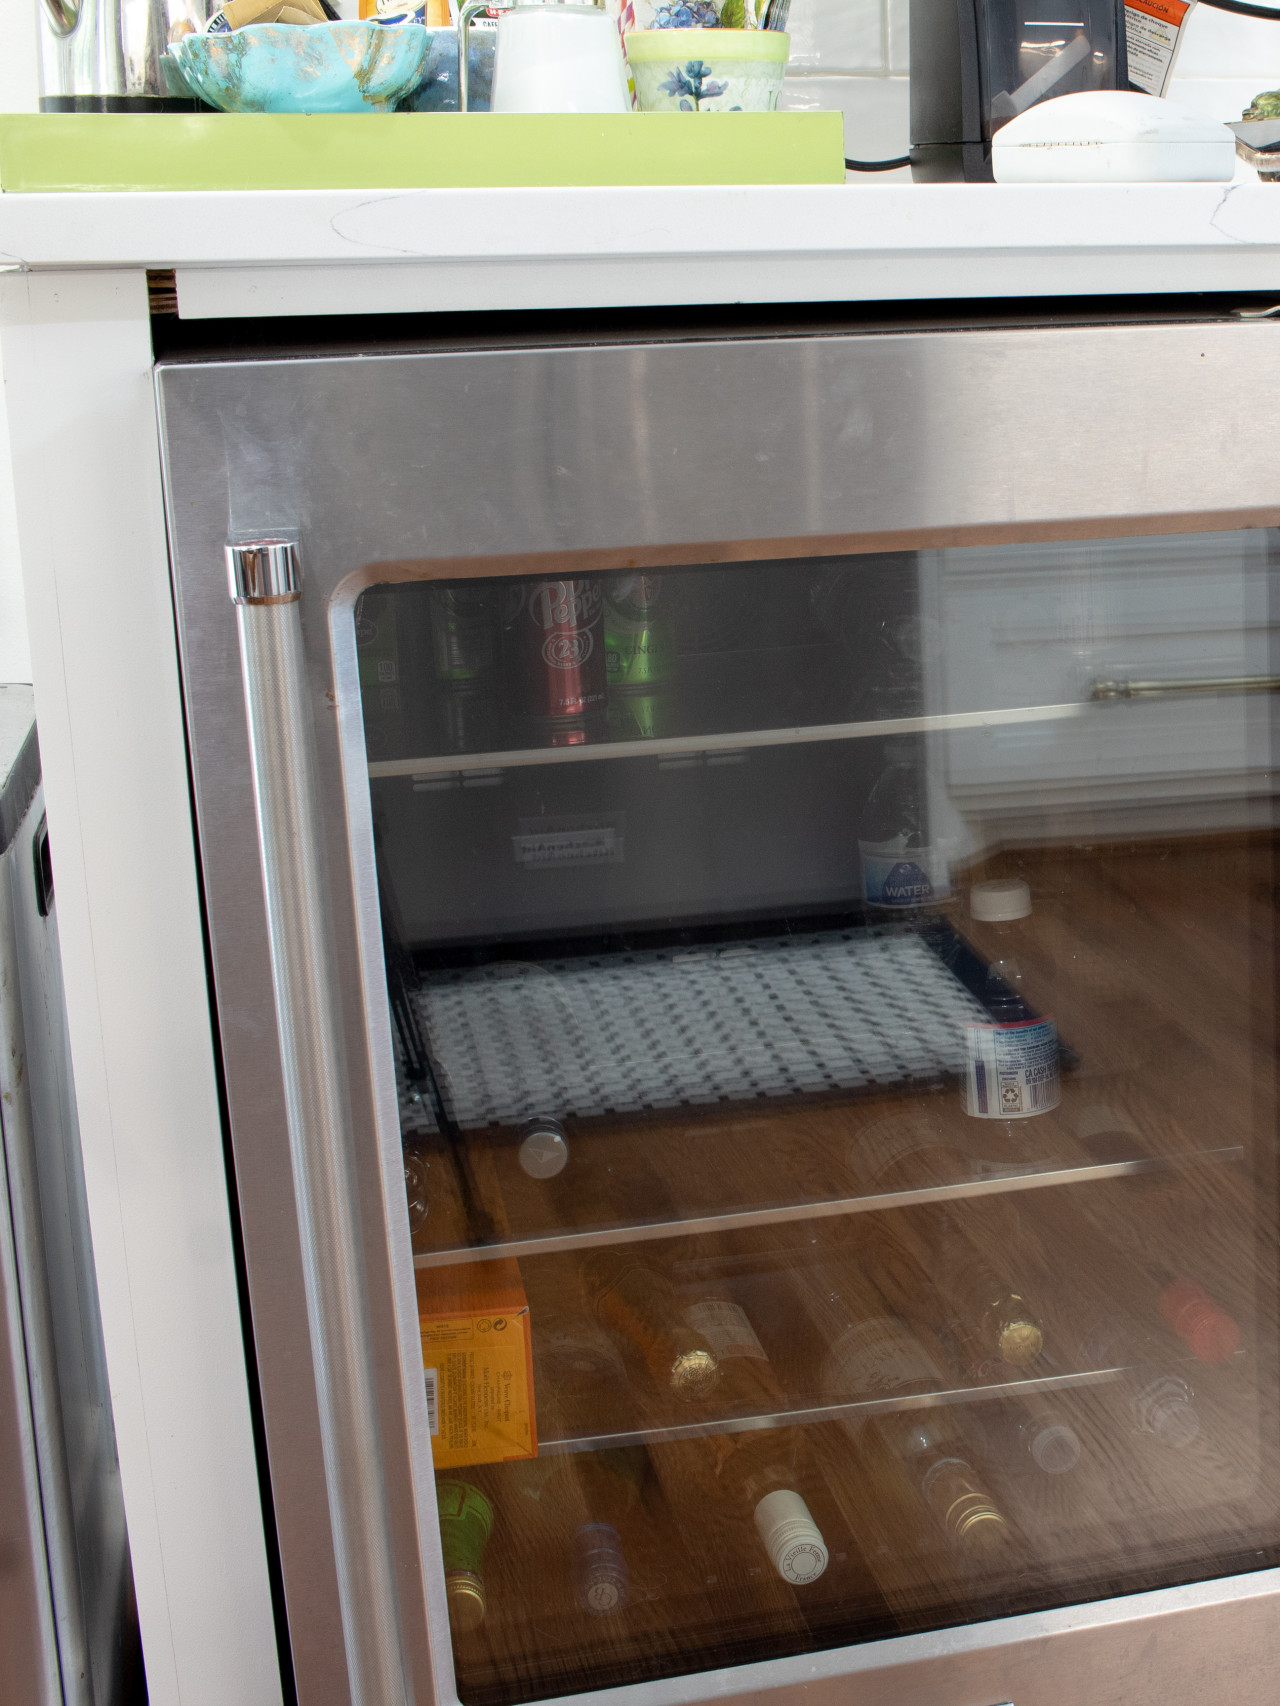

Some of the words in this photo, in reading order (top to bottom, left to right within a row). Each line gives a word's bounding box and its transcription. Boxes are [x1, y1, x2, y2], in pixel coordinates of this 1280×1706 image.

[541, 580, 602, 630] Peppe
[558, 639, 580, 659] 23
[886, 884, 930, 897] WATER
[1025, 1069, 1033, 1078] CA
[1033, 1066, 1046, 1077] CASH
[785, 1545, 807, 1561] Vieille
[785, 1562, 791, 1572] La
[795, 1572, 817, 1581] France
